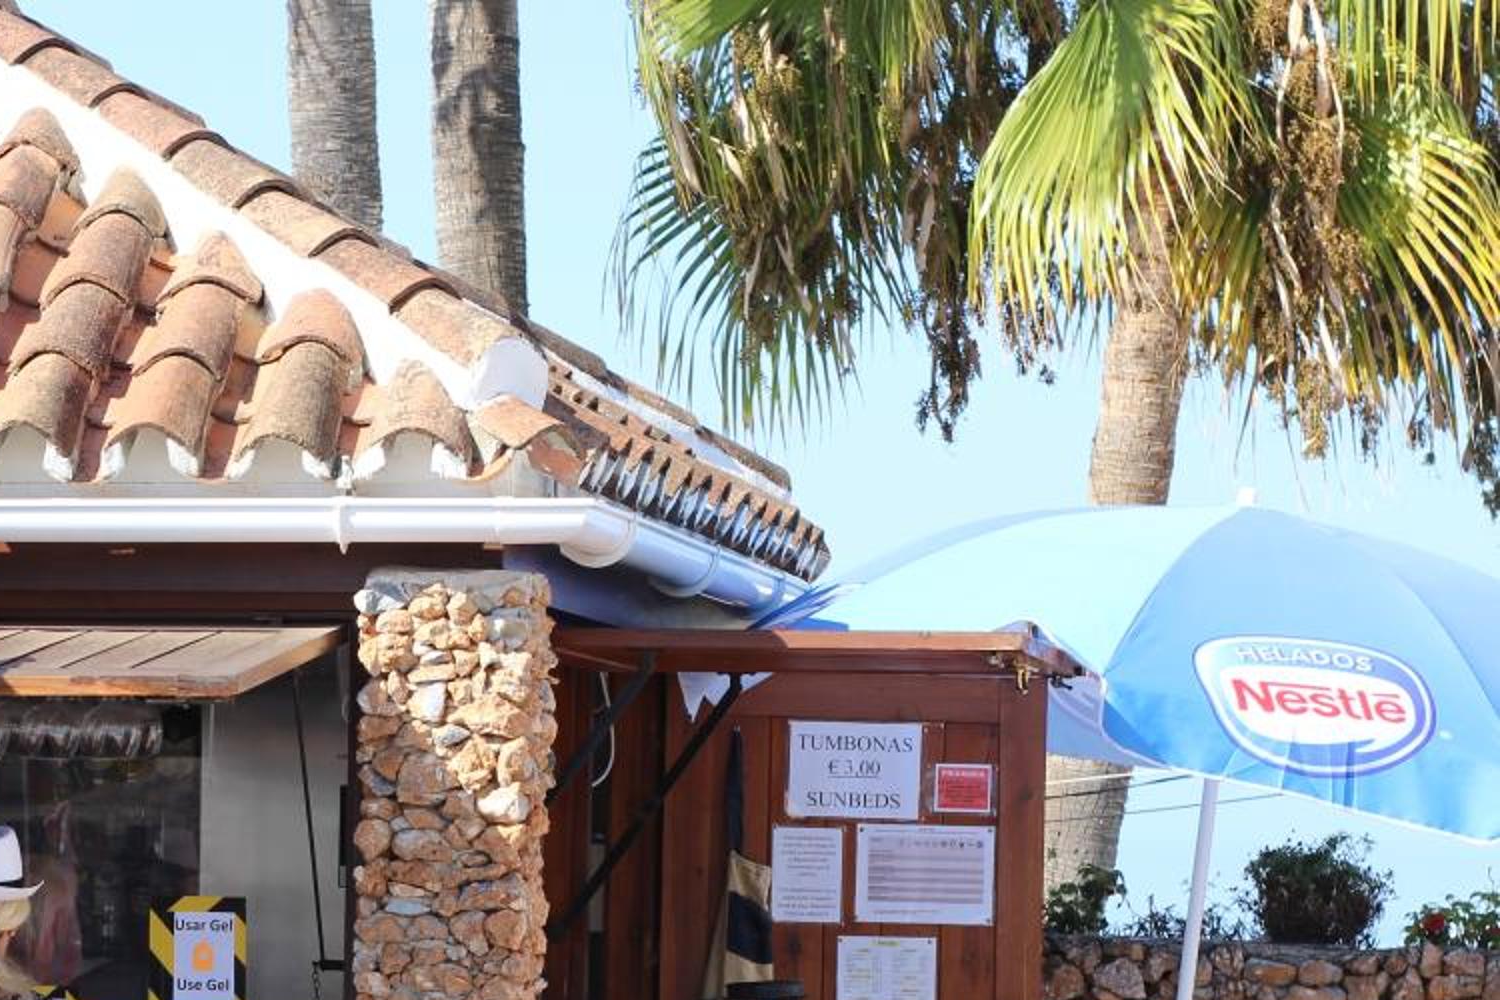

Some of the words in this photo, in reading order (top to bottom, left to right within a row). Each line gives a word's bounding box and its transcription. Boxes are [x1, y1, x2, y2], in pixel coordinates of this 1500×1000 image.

[1236, 646, 1373, 672] HELADOS
[1230, 678, 1406, 725] Nestlé
[798, 733, 914, 753] TUMBONAS
[806, 790, 901, 810] SUNBEDS
[175, 918, 206, 931] Usar
[209, 918, 233, 931] Gel
[177, 978, 203, 991] Use
[206, 978, 229, 991] Gel
